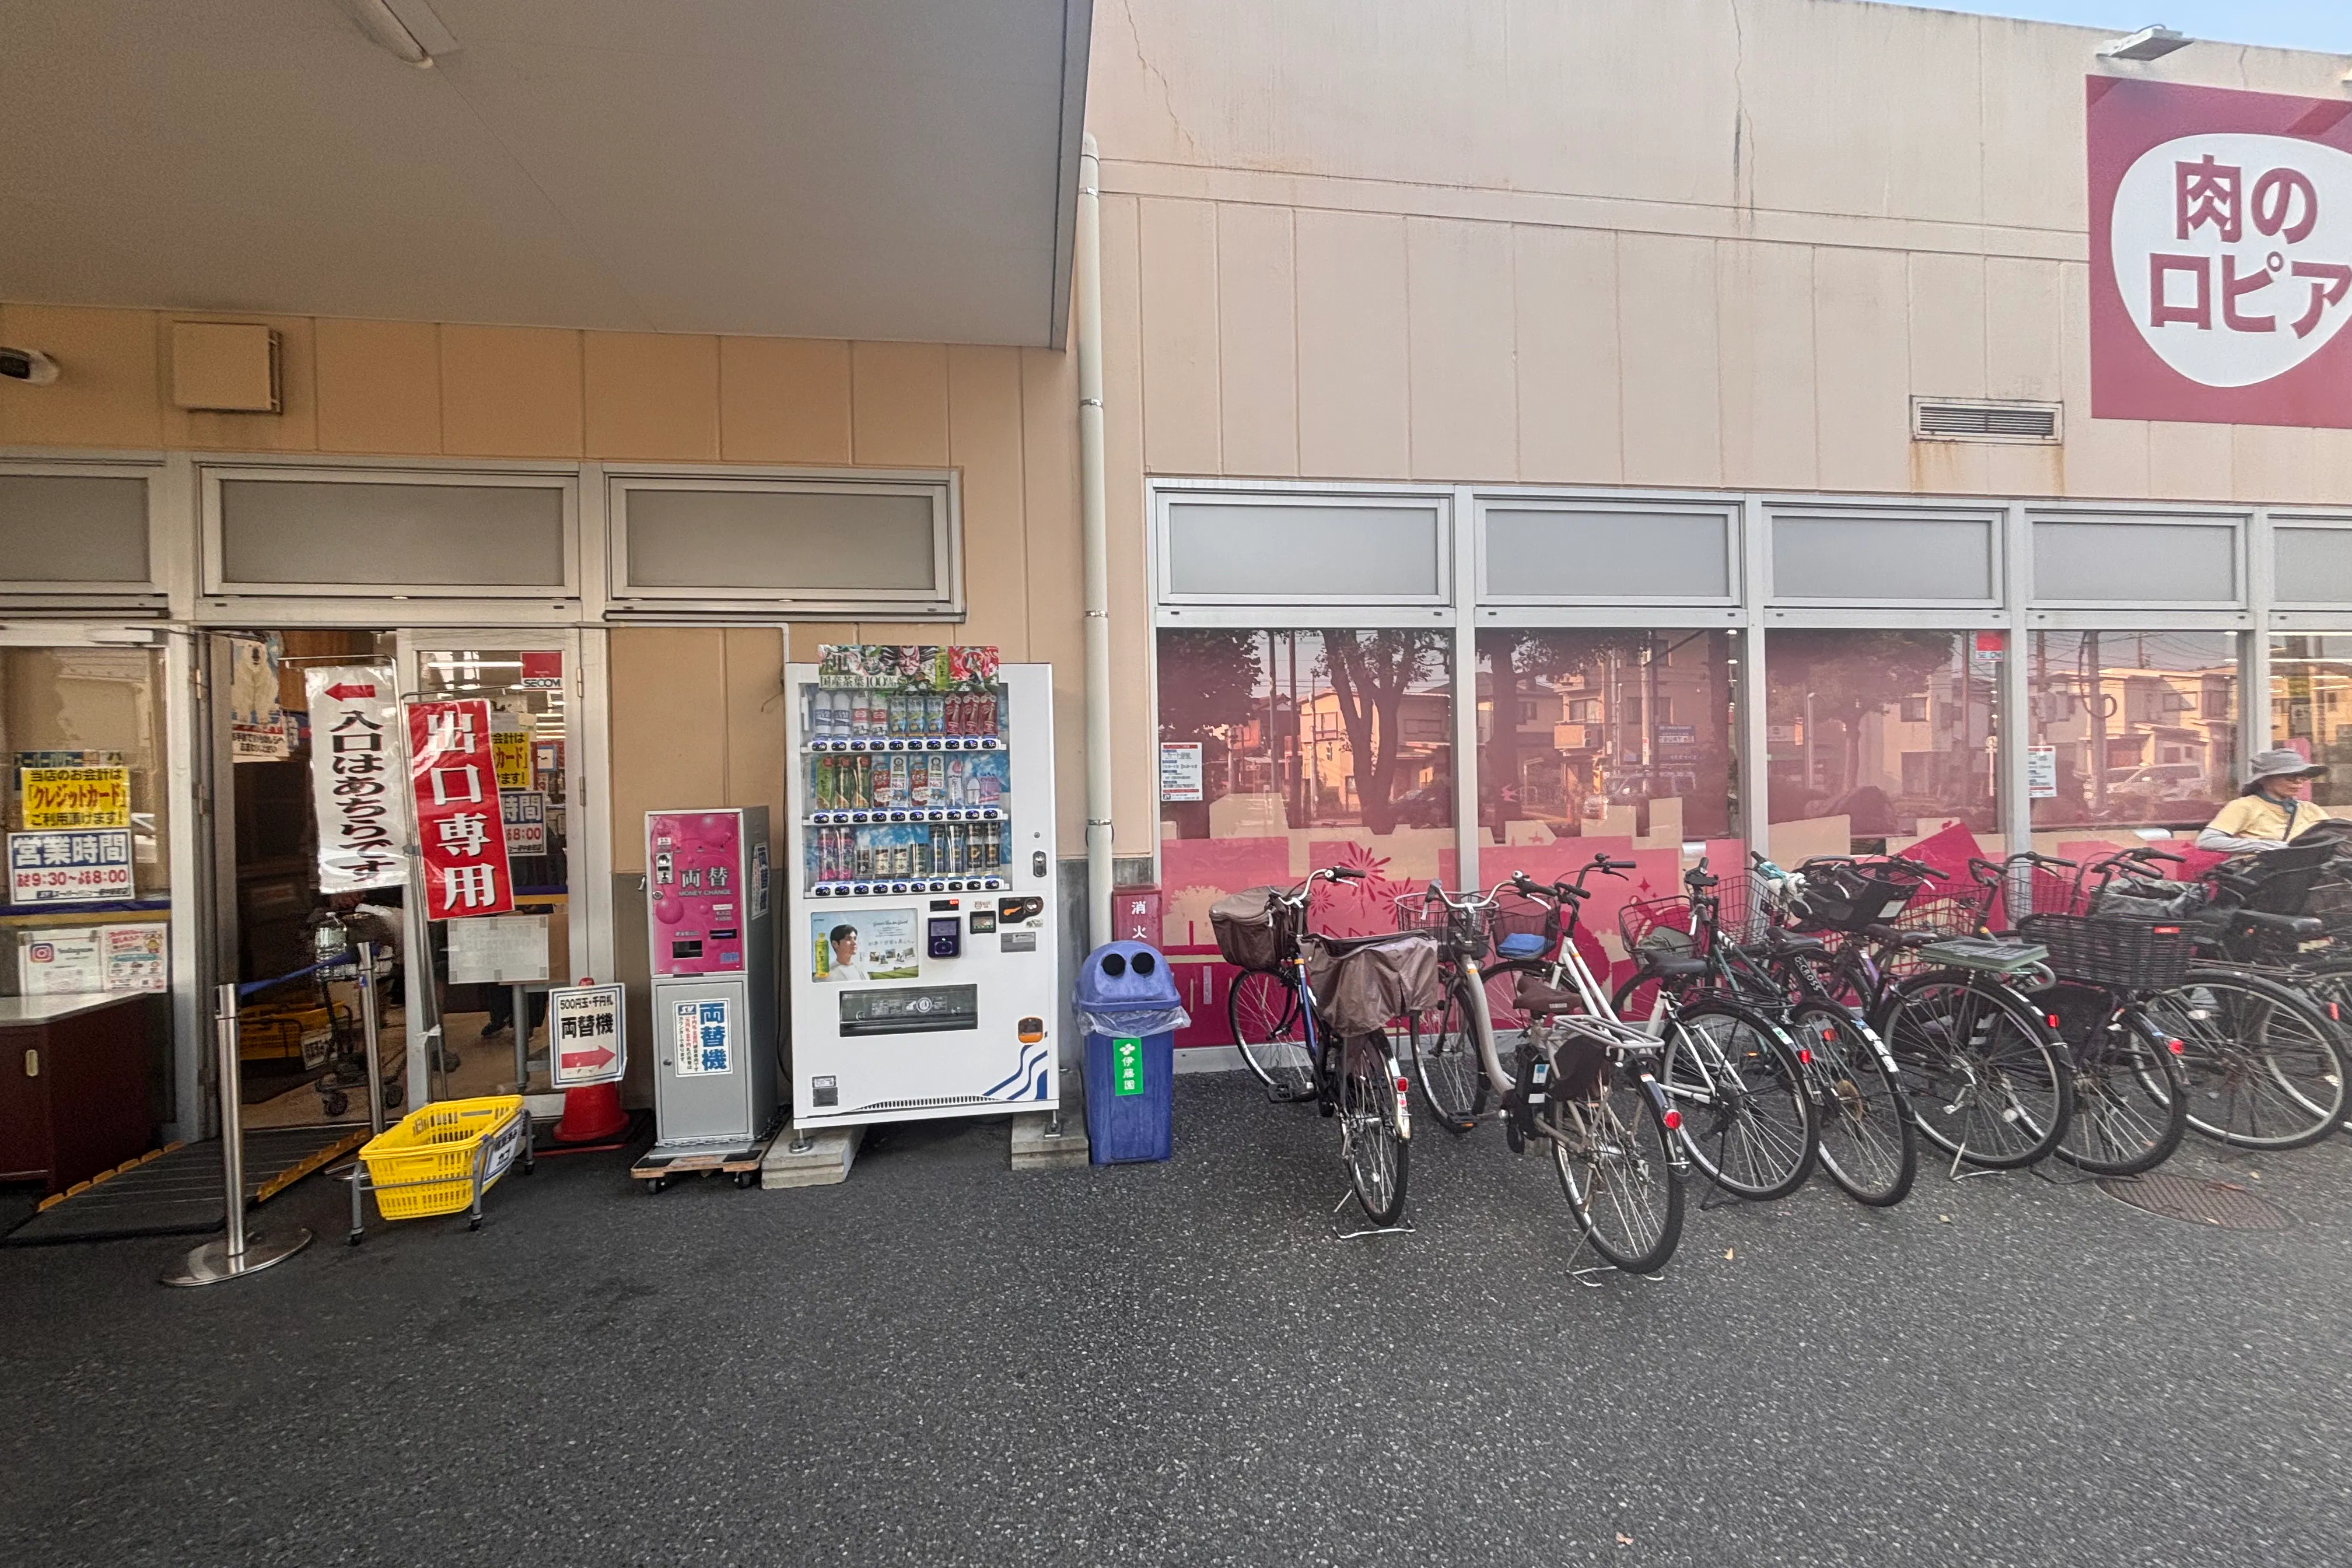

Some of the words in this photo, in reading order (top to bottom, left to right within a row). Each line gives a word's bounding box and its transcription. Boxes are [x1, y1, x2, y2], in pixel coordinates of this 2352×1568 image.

[2175, 154, 2318, 244] 肉の
[2149, 251, 2351, 339] ロピア
[524, 679, 561, 687] SECOM
[30, 769, 123, 782] 当店のお会計は
[330, 710, 397, 882] 入口はあちらです
[426, 710, 498, 911] 出口専用
[13, 835, 127, 866] 営業時間
[680, 867, 729, 888] 両替
[1131, 901, 1147, 939] 消火
[560, 995, 614, 1010] 500円玉・千円札
[561, 1013, 614, 1040] 両替機
[699, 1002, 727, 1071] 両替機
